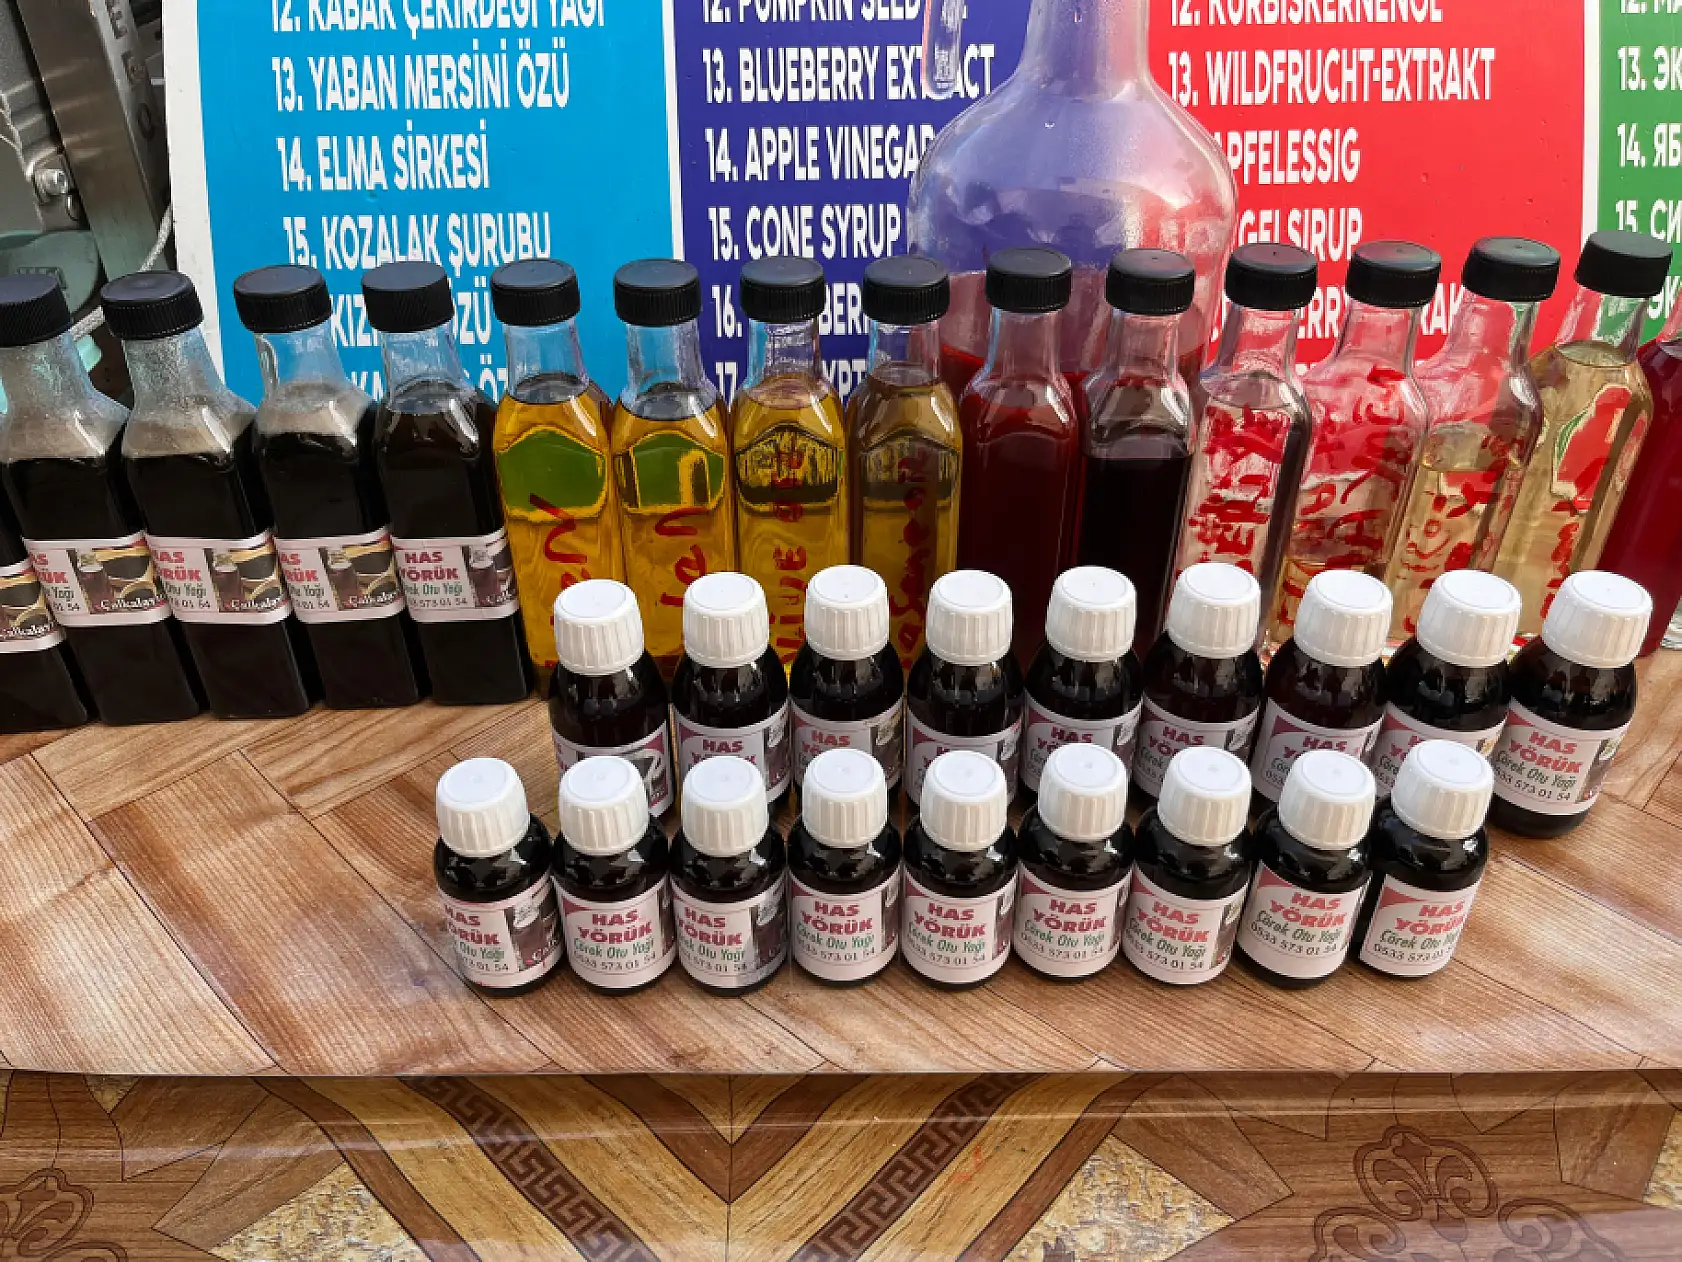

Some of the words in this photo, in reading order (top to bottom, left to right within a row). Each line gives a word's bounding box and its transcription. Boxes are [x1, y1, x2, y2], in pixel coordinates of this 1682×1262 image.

[272, 57, 303, 112] 13.
[308, 54, 397, 111] YABAN
[405, 39, 509, 109] MERSİNİ
[517, 37, 570, 109] ÖZÜ
[703, 48, 733, 104] 13.
[739, 46, 880, 103] BLUEBERRY
[1168, 50, 1199, 107] 13.
[1205, 47, 1495, 106] WILDFRUCHT-EXTRAKT
[1617, 47, 1647, 91] 13.
[276, 136, 313, 191] 14.
[317, 135, 389, 191] ELMA
[393, 118, 491, 190] SİRKESİ
[705, 127, 738, 183] 14.
[744, 126, 820, 183] APPLE
[1213, 127, 1361, 185] PFELESSIG
[1617, 123, 1646, 168] 14.
[283, 216, 317, 266] 15.
[322, 214, 440, 270] KOZALAK
[448, 211, 552, 279] ŞURUBU
[708, 206, 739, 262] 15.
[745, 205, 814, 259] CONE
[821, 203, 902, 261] SYRUP
[711, 284, 743, 338] 16.
[404, 551, 443, 564] HAS
[703, 739, 744, 754] HAS
[811, 730, 851, 746] HAS
[1051, 726, 1094, 744] HAS
[1162, 726, 1204, 746] HAS
[1303, 736, 1348, 752] HAS
[1529, 731, 1579, 755] HAS
[1509, 739, 1584, 774] YÖRÜK
[814, 900, 861, 917] HAS
[927, 901, 976, 921] HAS
[1048, 898, 1099, 916] HAS
[1153, 900, 1201, 925] HAS
[1268, 899, 1348, 928] YÖRÜK
[1291, 892, 1343, 911] HAS
[1418, 899, 1466, 917] HAS
[592, 909, 640, 926] HAS
[684, 906, 727, 928] HAS
[799, 909, 874, 936] YÖRÜK
[913, 909, 987, 939] YÖRÜK
[1031, 907, 1108, 933] YÖRÜK
[1135, 906, 1211, 943] YÖRÜK
[1395, 914, 1467, 935] YÖRÜK
[578, 921, 653, 945] YÖRÜK
